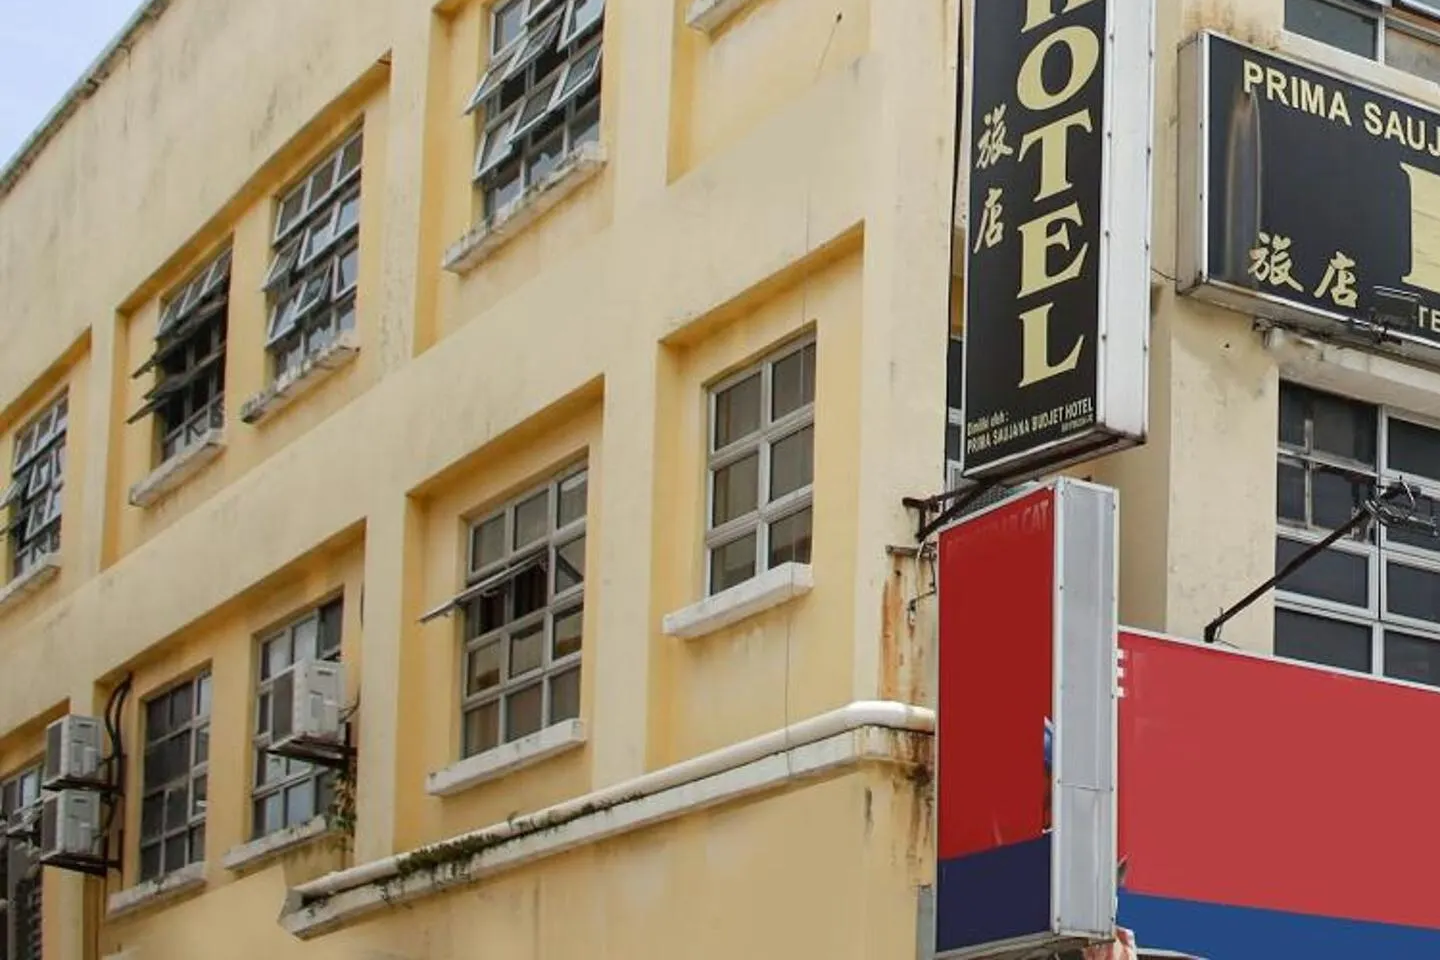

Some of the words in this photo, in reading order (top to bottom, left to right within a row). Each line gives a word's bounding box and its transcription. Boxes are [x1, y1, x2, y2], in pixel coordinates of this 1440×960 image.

[1243, 59, 1352, 127] PRIMA
[1248, 232, 1360, 309] 旅店
[993, 420, 1030, 446] SAUJANA
[1065, 397, 1094, 419] HOTEL
